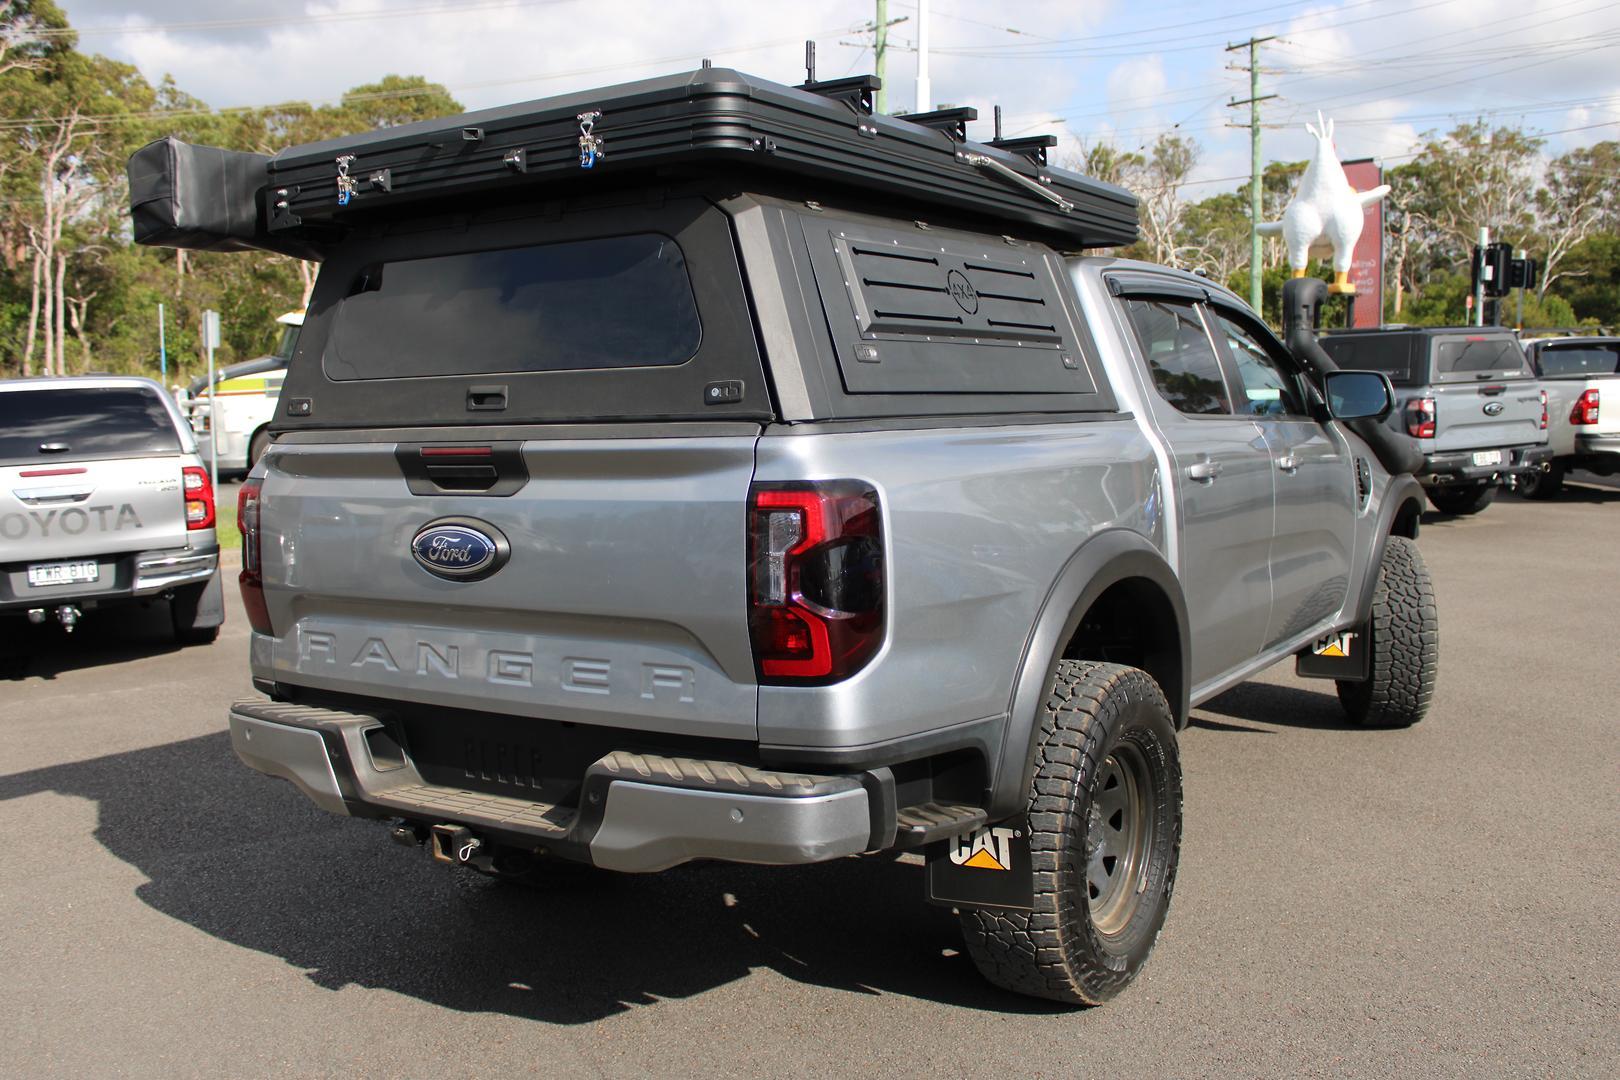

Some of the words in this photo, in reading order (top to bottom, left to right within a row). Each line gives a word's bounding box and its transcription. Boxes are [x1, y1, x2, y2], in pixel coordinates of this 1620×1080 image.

[429, 535, 472, 562] Ford
[1312, 632, 1354, 656] CAT
[302, 630, 695, 702] RANGER
[949, 826, 1014, 871] CAT
